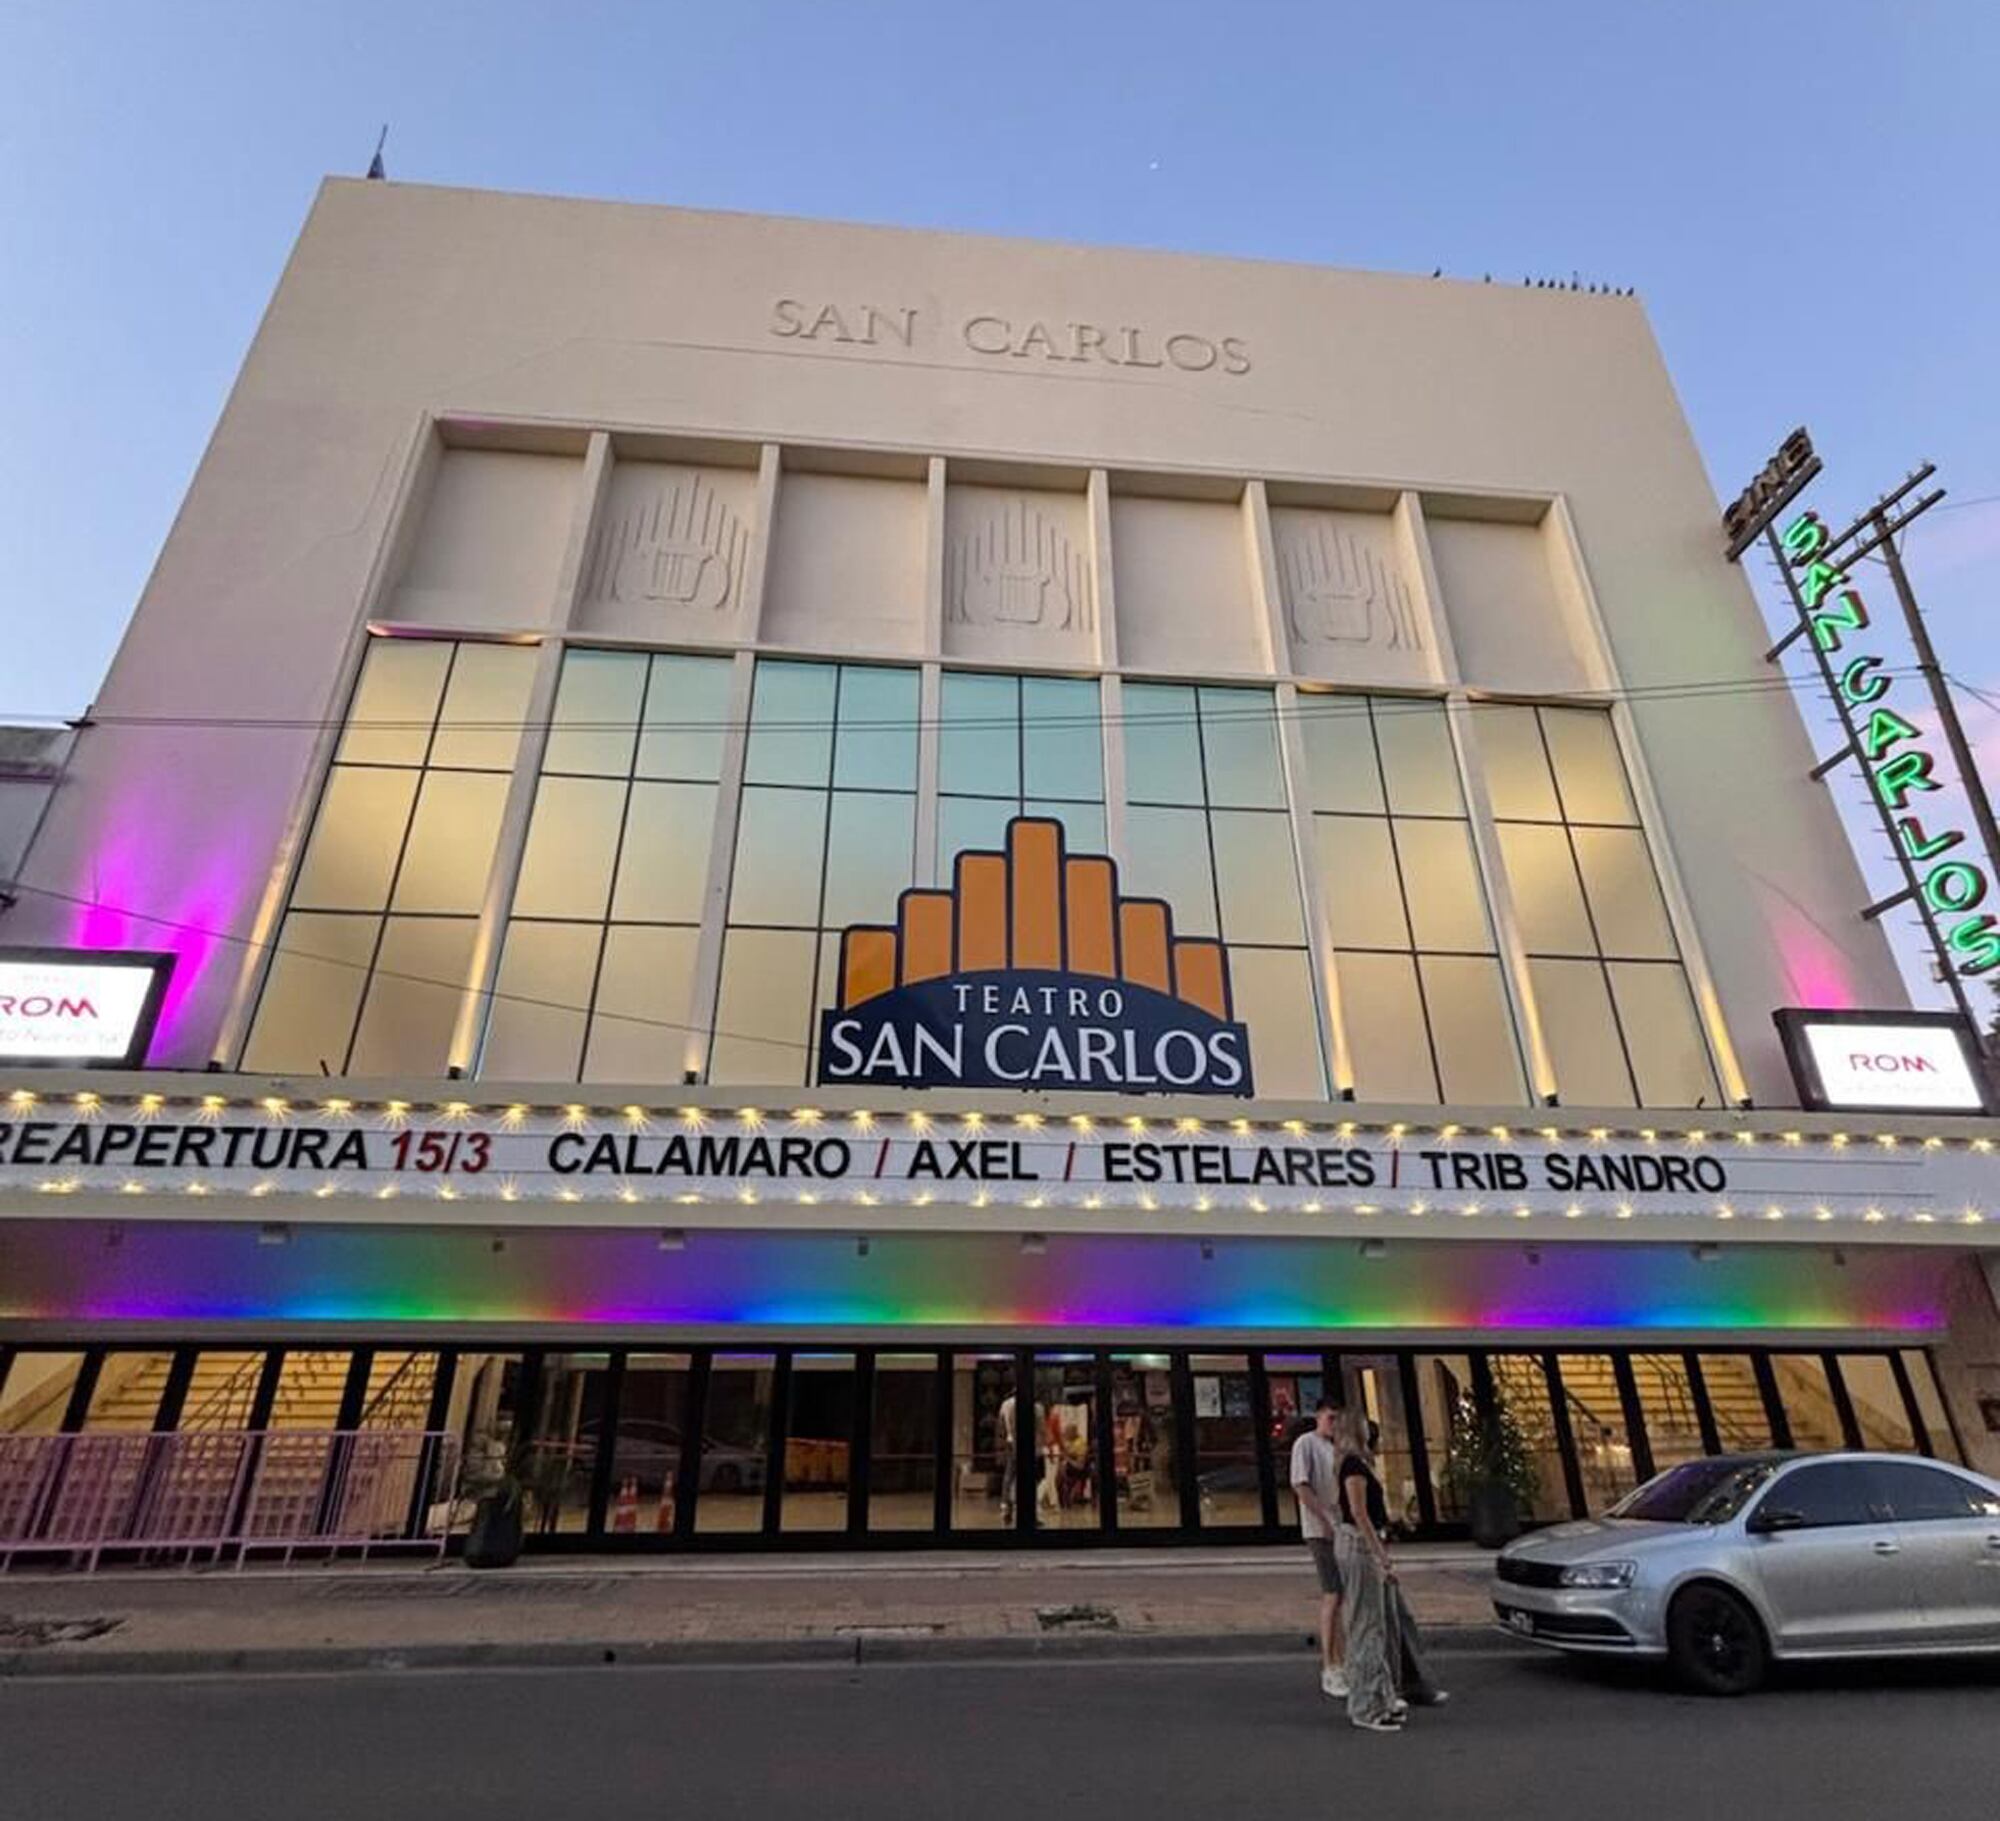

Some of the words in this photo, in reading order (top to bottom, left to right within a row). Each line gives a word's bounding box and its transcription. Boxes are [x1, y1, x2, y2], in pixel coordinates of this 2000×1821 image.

[769, 298, 918, 348] SAN
[962, 315, 1252, 375] CARLOS
[1782, 510, 1868, 652] SAN
[1840, 656, 2000, 976] CARLOS
[953, 984, 1123, 1018] TEATRO
[828, 1019, 964, 1078] SAN
[984, 1024, 1243, 1086] CARLOS
[1849, 1053, 1940, 1073] ROM
[390, 1130, 490, 1174] 15/3
[548, 1132, 851, 1178] CALAMARO
[907, 1139, 1039, 1181] AXEL
[1103, 1142, 1375, 1188] ESTELARES
[1419, 1151, 1528, 1191] TRIB
[1546, 1153, 1727, 1193] SANDRO
